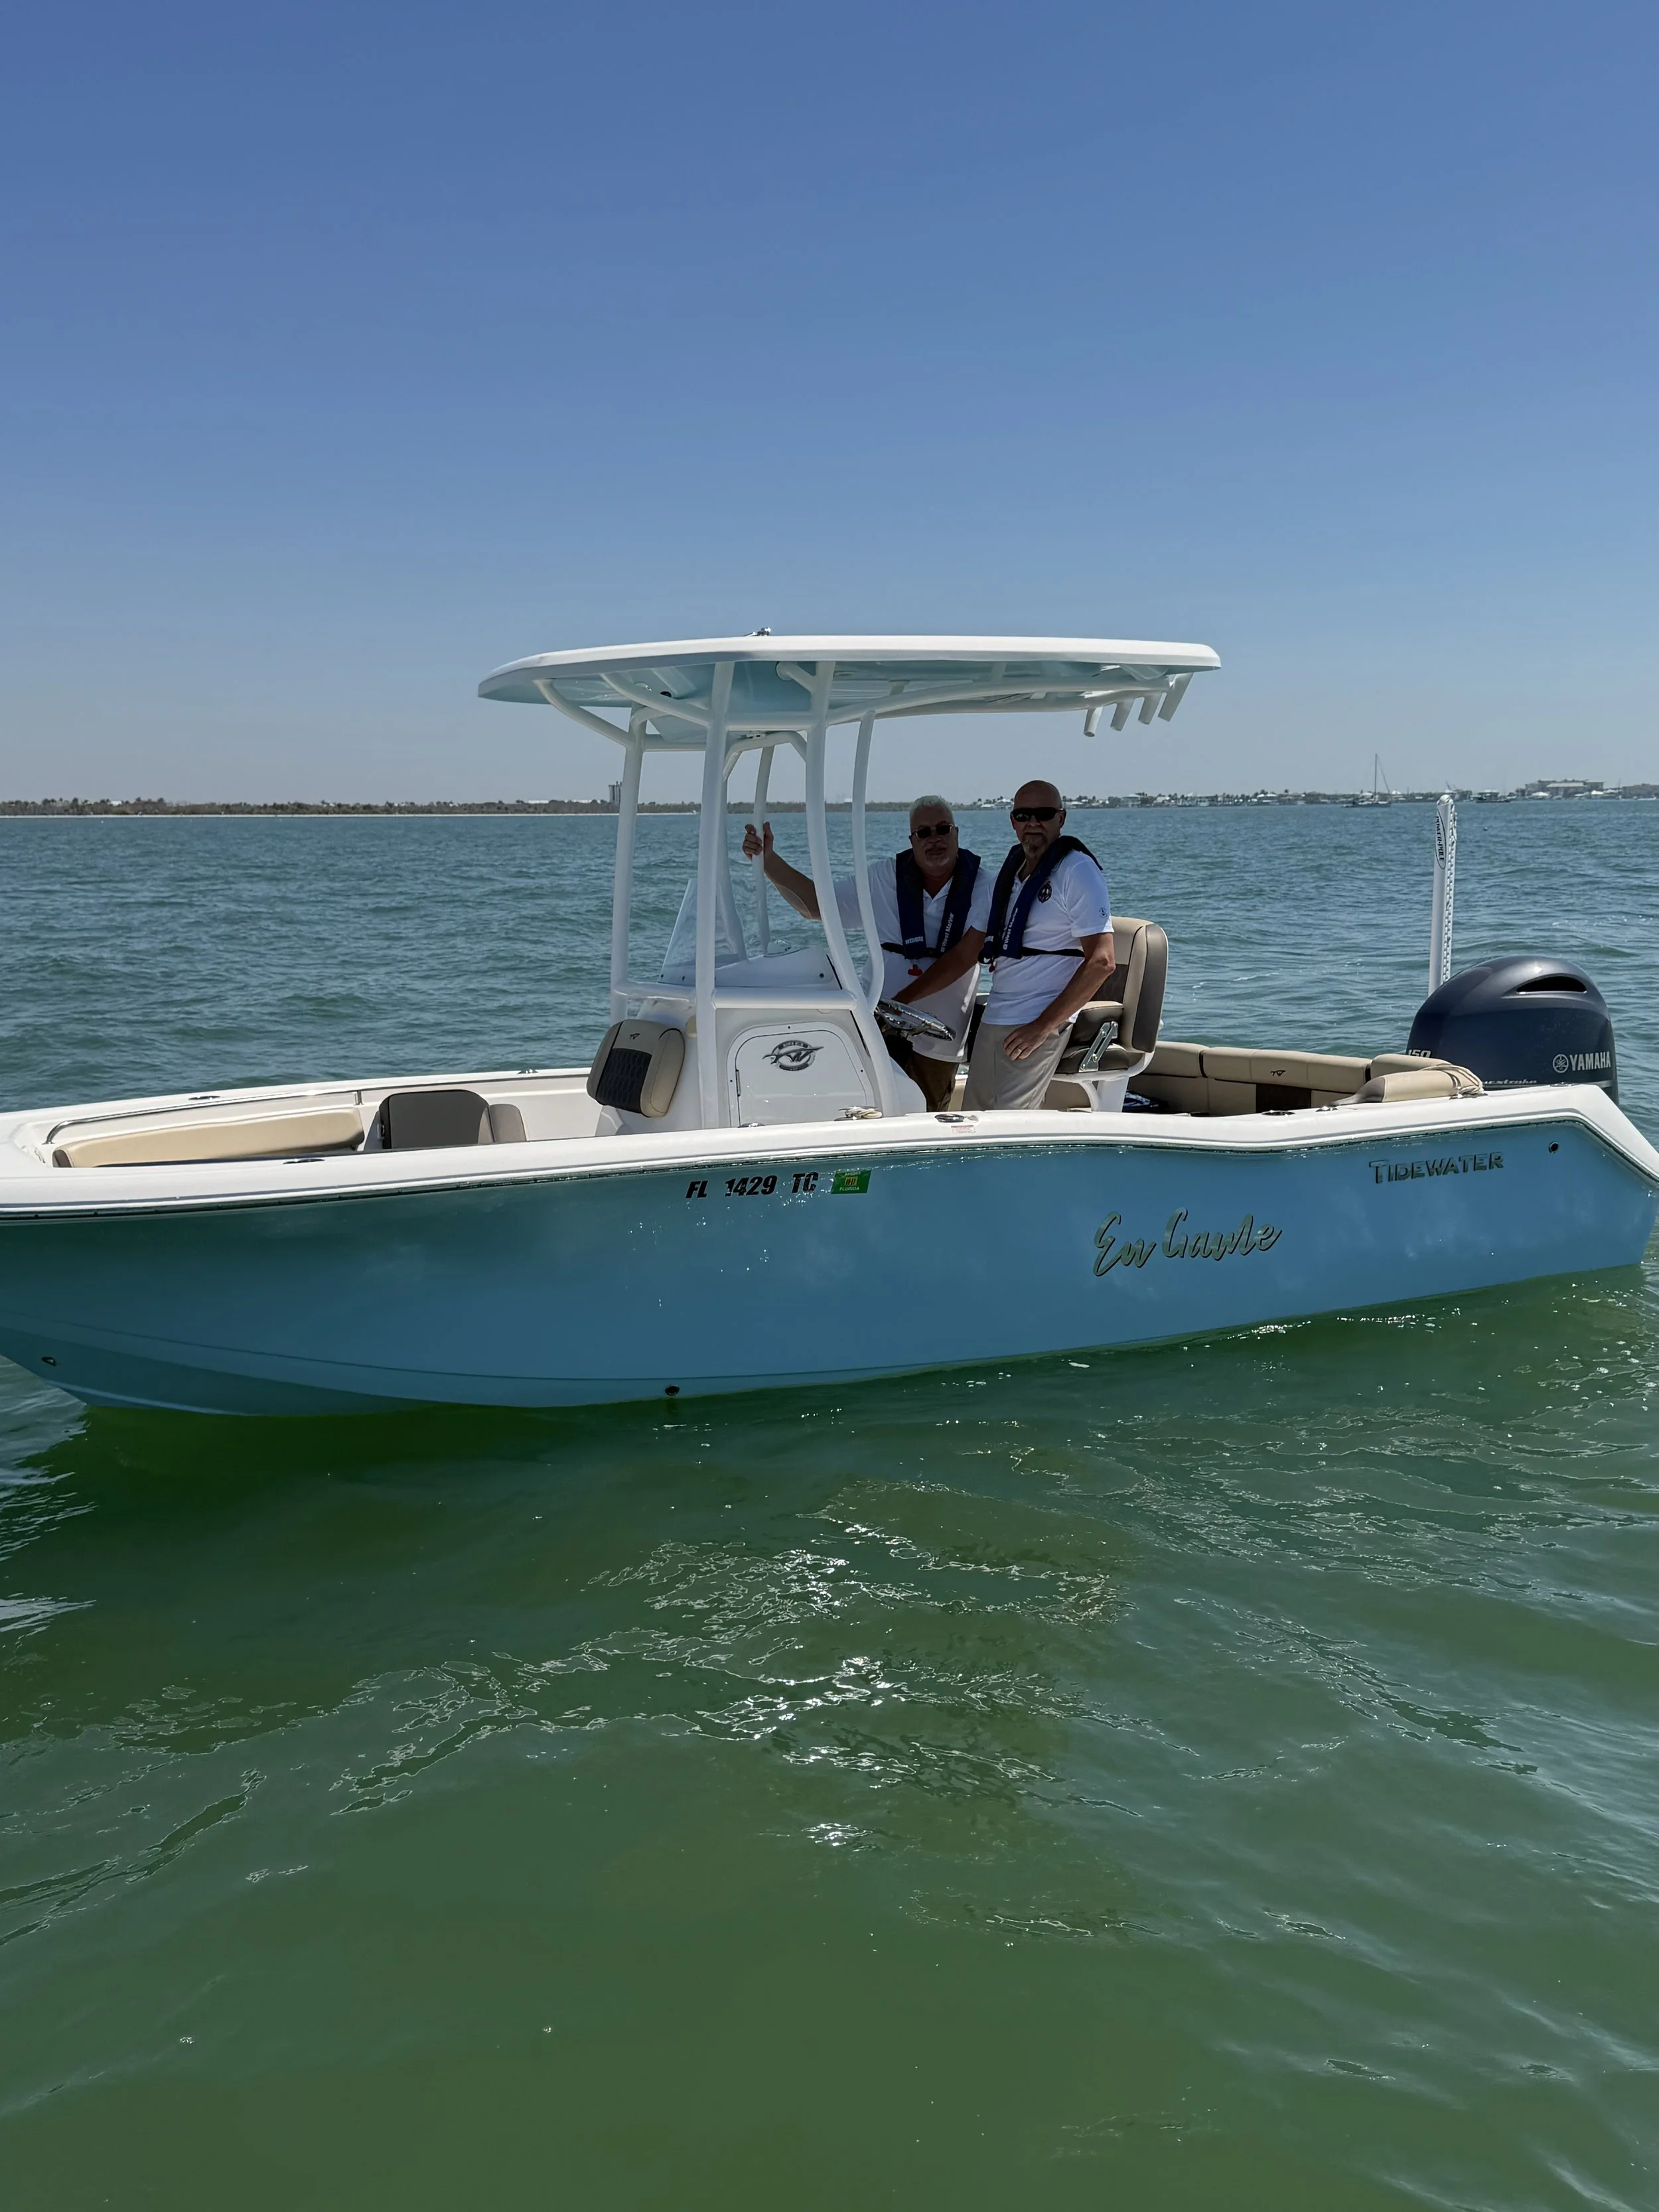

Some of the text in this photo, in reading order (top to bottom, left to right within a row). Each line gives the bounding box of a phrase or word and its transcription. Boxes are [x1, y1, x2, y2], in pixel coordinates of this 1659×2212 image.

[1569, 1051, 1611, 1071] YAMAHA
[1369, 1151, 1504, 1184] TIDEWATER
[685, 1180, 709, 1199] FL
[725, 1175, 778, 1197] 1429
[792, 1171, 819, 1194] TC
